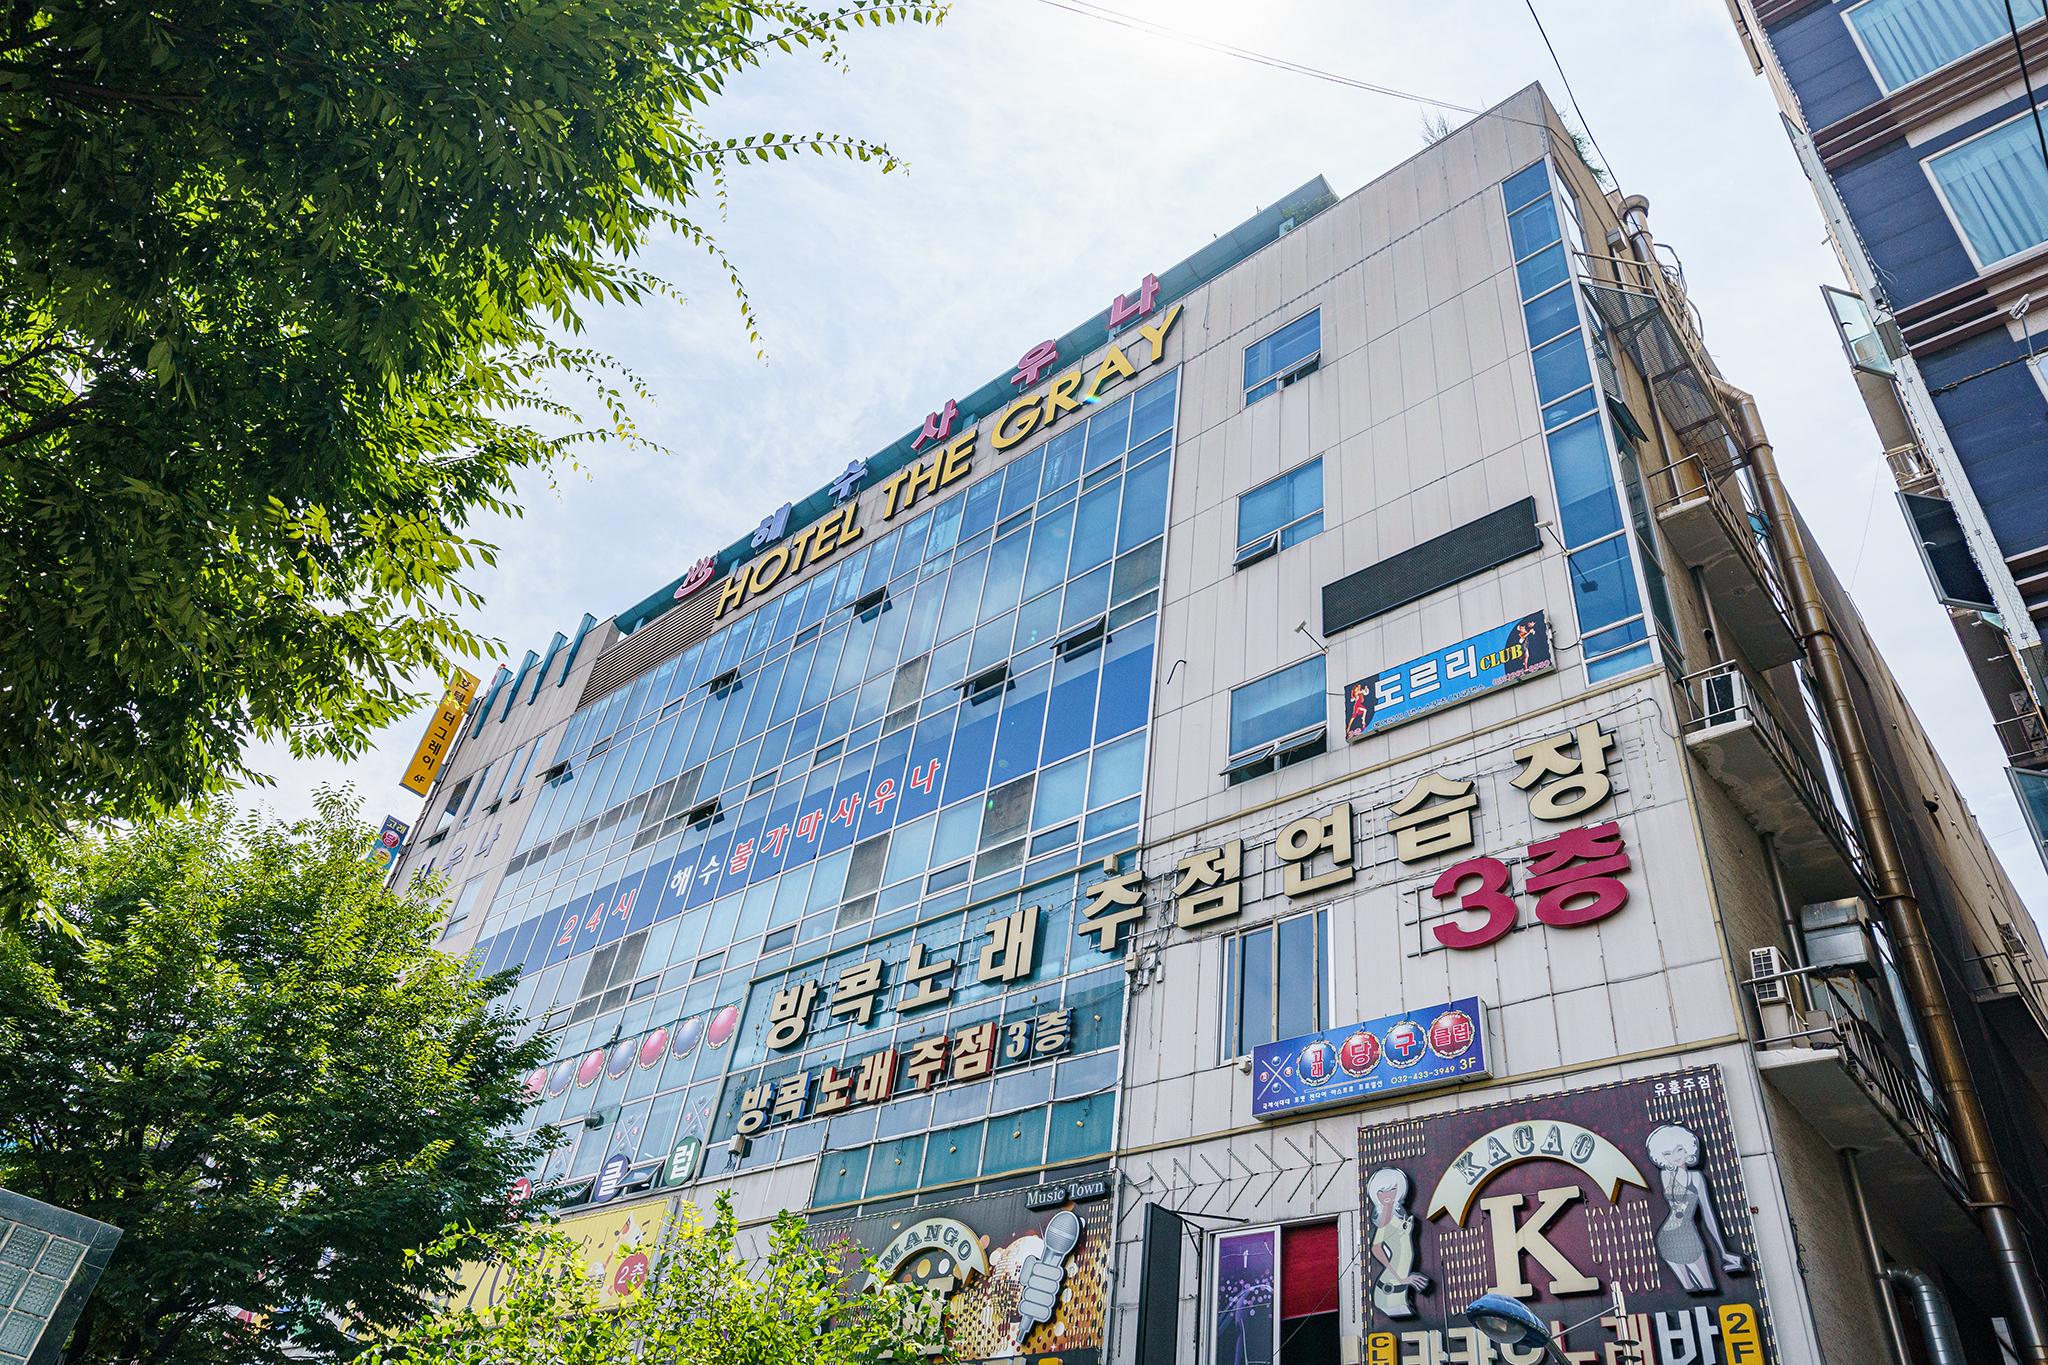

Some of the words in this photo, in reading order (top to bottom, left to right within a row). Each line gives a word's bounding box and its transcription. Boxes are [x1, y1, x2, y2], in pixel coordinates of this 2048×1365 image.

[714, 502, 863, 619] HOTEL
[883, 429, 978, 520] THE
[991, 304, 1184, 453] GRAY
[1373, 644, 1478, 712] 도르리
[1479, 643, 1523, 671] CLUB
[413, 774, 425, 784] 6F
[1432, 822, 1631, 950] 3층
[557, 889, 636, 947] 24시
[1006, 1009, 1073, 1061] 3층
[1390, 1065, 1455, 1084] 032-433-3949
[1459, 1057, 1476, 1070] 3F
[1654, 1074, 1710, 1097] 유흥주점
[1453, 1124, 1596, 1186] KACAO
[1027, 1187, 1065, 1206] Music
[1068, 1181, 1104, 1200] Town
[881, 1224, 972, 1269] MANGO
[1481, 1185, 1600, 1298] K
